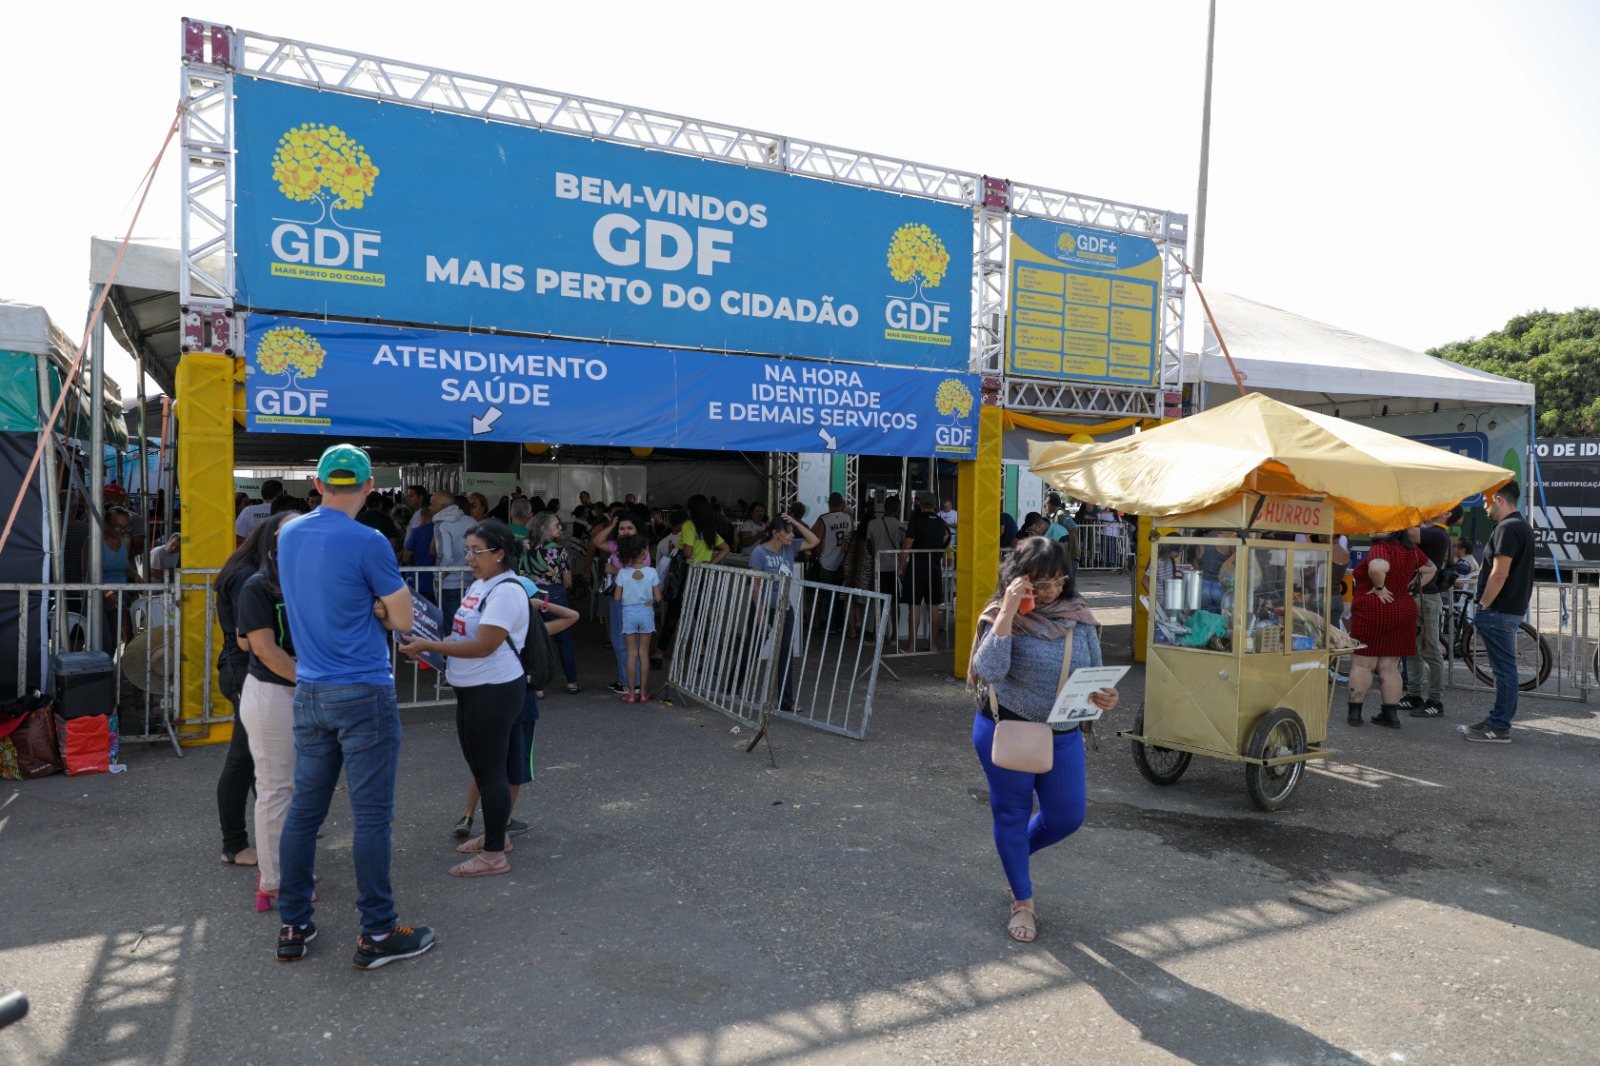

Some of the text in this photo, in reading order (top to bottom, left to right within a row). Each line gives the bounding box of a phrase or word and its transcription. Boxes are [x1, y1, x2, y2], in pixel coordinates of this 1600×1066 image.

[555, 171, 768, 229] BEM-VINDOS
[270, 223, 382, 269] GDF
[592, 213, 734, 277] GDF
[1076, 234, 1117, 254] GDF+
[274, 266, 384, 284] MAIS PERTO DO CIDADÃO
[425, 254, 859, 328] MAIS PERTO DO CIDADÃO
[885, 299, 951, 333] GDF
[372, 343, 608, 381] ATENDIMENTO
[764, 364, 863, 389] NA HORA
[255, 389, 329, 417] GDF
[441, 376, 551, 408] SAÚDE
[751, 383, 881, 409] IDENTIDADE
[708, 401, 918, 434] E DEMAIS SERVIÇOS
[935, 426, 973, 447] GDF
[1552, 443, 1576, 457] DE
[1579, 443, 1600, 457] ID
